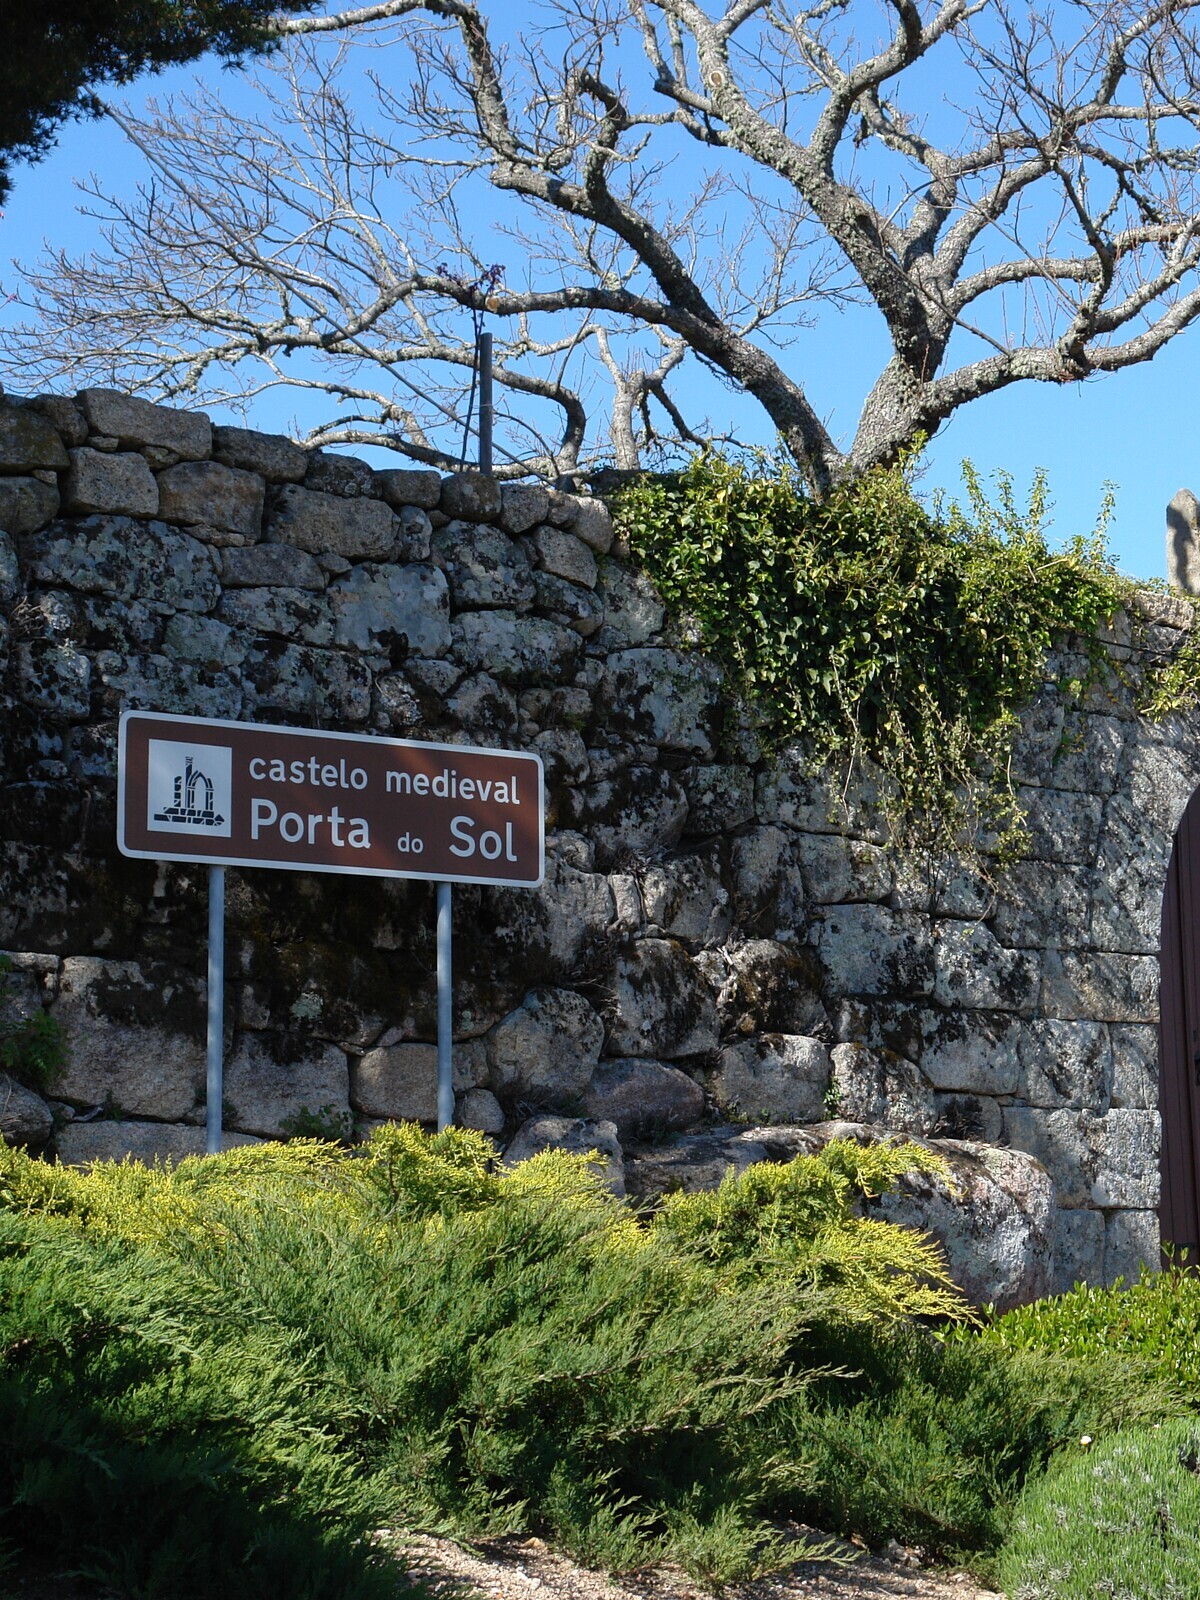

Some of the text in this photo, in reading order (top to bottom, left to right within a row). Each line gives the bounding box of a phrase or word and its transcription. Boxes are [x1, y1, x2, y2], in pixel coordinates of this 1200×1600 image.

[249, 756, 520, 805] castelo medieval
[251, 798, 518, 862] Porta do Sol
